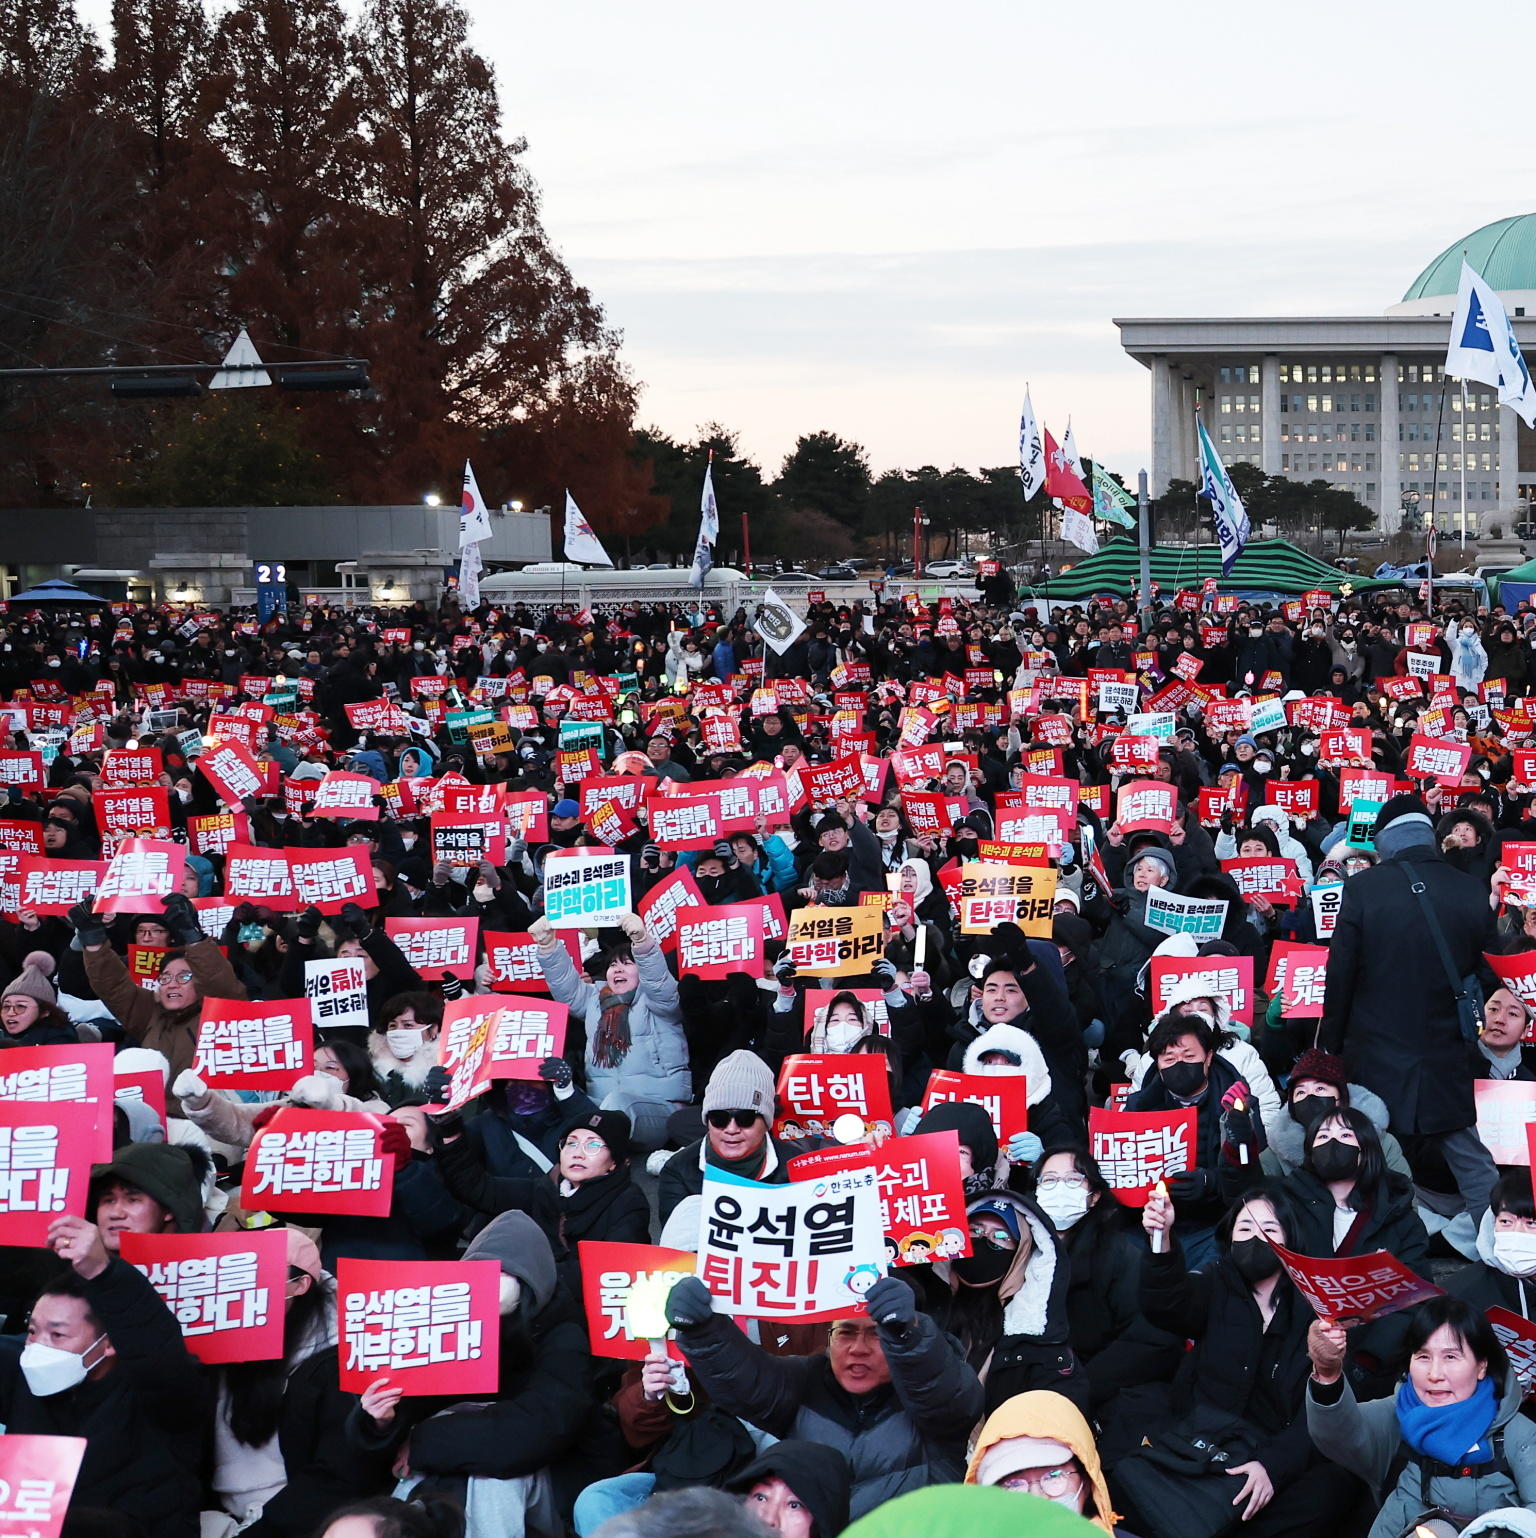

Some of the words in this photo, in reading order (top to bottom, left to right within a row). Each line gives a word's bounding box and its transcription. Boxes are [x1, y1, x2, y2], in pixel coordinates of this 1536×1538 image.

[257, 565, 271, 583] 2
[1391, 681, 1415, 693] 탄핵
[32, 707, 62, 724] 탄핵
[560, 750, 590, 763] 내란죄
[1029, 750, 1055, 763] 내란죄
[1113, 744, 1151, 763] 탄핵
[1328, 736, 1363, 756] 탄핵
[106, 755, 154, 772] 윤석열을
[106, 769, 155, 782] 탄핵하라
[561, 761, 593, 774] 윤석열
[904, 752, 943, 778] 탄핵
[811, 766, 854, 786] 내란수괴
[454, 795, 497, 814] 탄핵
[1025, 785, 1071, 801] 윤석열을
[1275, 789, 1311, 810] 탄핵
[103, 796, 155, 815] 윤석열을
[652, 804, 711, 826] 윤석열을
[105, 812, 157, 829] 탄핵하라
[194, 816, 235, 832] 내란죄
[652, 820, 717, 844] 거부한다!
[195, 828, 237, 848] 윤석열
[434, 831, 482, 848] 윤석열을
[435, 848, 483, 863] 체포하라
[980, 843, 1011, 858] 내란수괴
[1011, 845, 1045, 859] 윤석열
[228, 857, 290, 877] 윤석열을
[291, 855, 357, 885] 윤석열을
[546, 867, 581, 890] 내란수괴
[582, 859, 625, 884] 윤석열을
[26, 870, 98, 891] 윤석열을
[227, 873, 293, 898] 거부한다!
[293, 874, 368, 906] 거부한다!
[960, 874, 1034, 898] 윤석열을
[545, 878, 627, 921] 탄핵하라
[968, 896, 1055, 925] 탄핵하라
[1149, 897, 1186, 914] 내란수괴
[1186, 901, 1225, 915] 윤석열을
[679, 915, 748, 943] 윤석열을
[790, 915, 854, 939] 윤석열을
[1147, 908, 1222, 936] 탄핵하라
[392, 925, 466, 951] 윤석열을
[680, 937, 755, 969] 거부한다!
[789, 935, 884, 968] 탄핵하라
[198, 1014, 293, 1051] 윤석열을
[193, 1040, 304, 1077] 거부한다!
[786, 1072, 870, 1117] 탄핵
[257, 1128, 376, 1166] 윤석열을
[1093, 1121, 1189, 1164] 거부한다!
[252, 1158, 382, 1196] 거부한다!
[830, 1175, 874, 1194] 한국노총
[893, 1195, 951, 1229] 체포
[707, 1195, 856, 1258] 윤석열
[701, 1254, 820, 1312] 퇴진!
[1310, 1266, 1404, 1296] 힘으로
[344, 1281, 472, 1328] 윤석열을
[1329, 1280, 1420, 1312] 지키자
[172, 1287, 269, 1339] 한다!
[345, 1320, 483, 1373] 거부한다!
